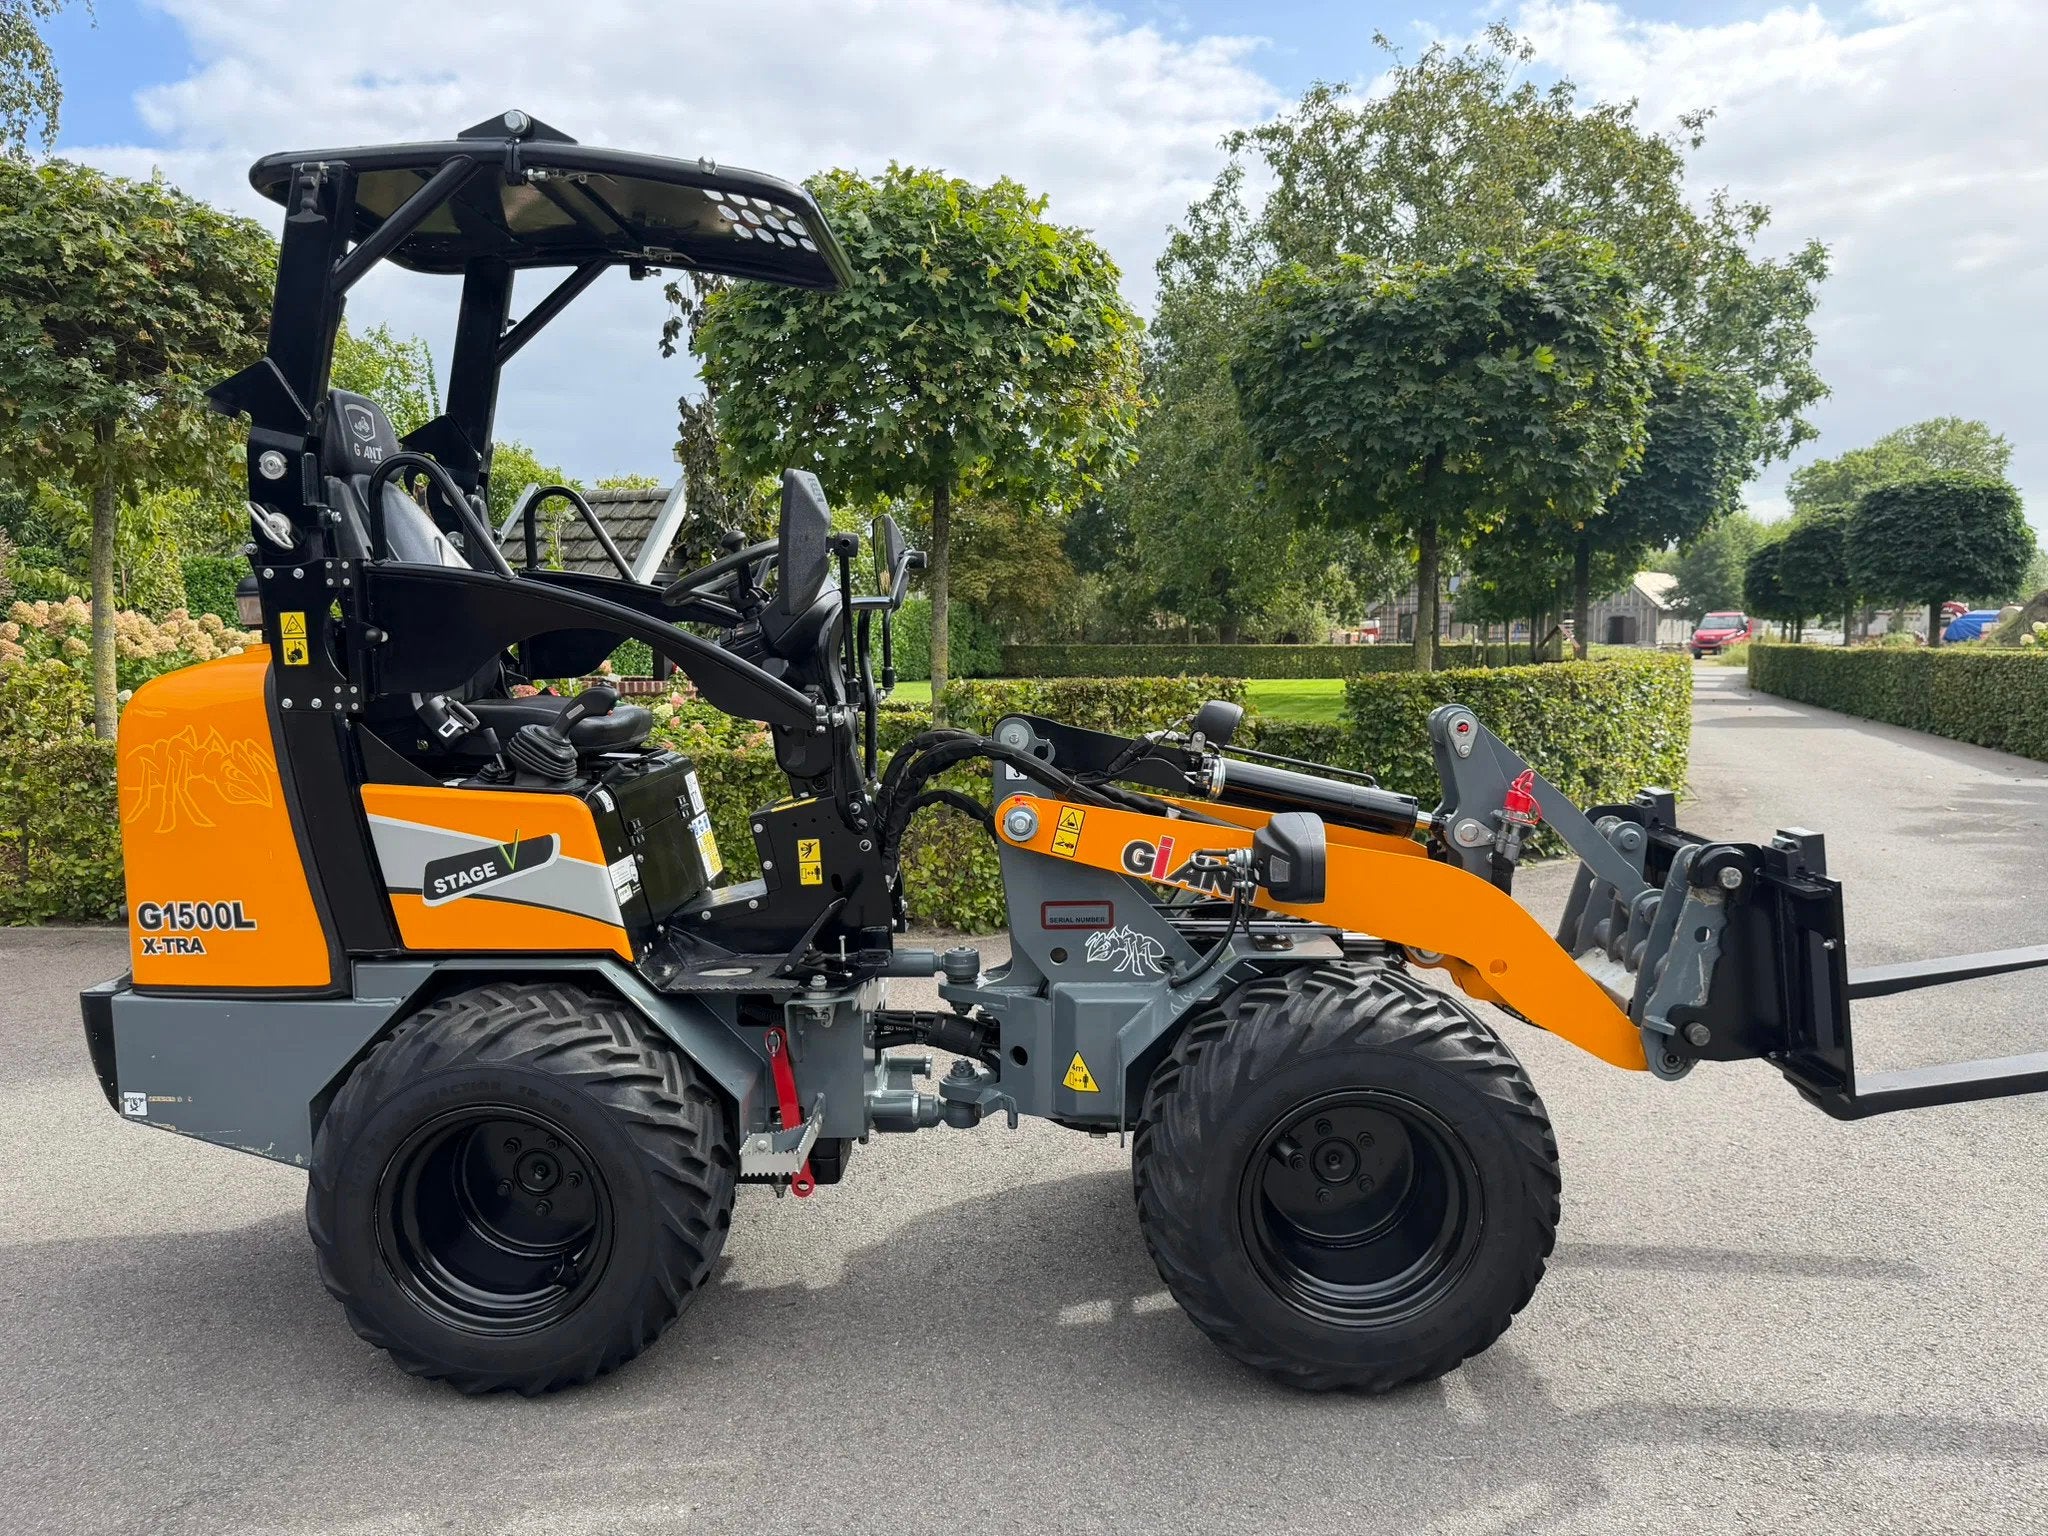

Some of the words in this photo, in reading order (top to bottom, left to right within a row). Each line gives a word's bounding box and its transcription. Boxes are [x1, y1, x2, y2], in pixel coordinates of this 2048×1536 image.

[354, 443, 382, 460] GANT
[433, 861, 498, 894] STAGE
[497, 828, 520, 871] V
[137, 901, 257, 931] G1500L
[141, 936, 207, 955] X-TRA
[1072, 1063, 1084, 1072] 4m
